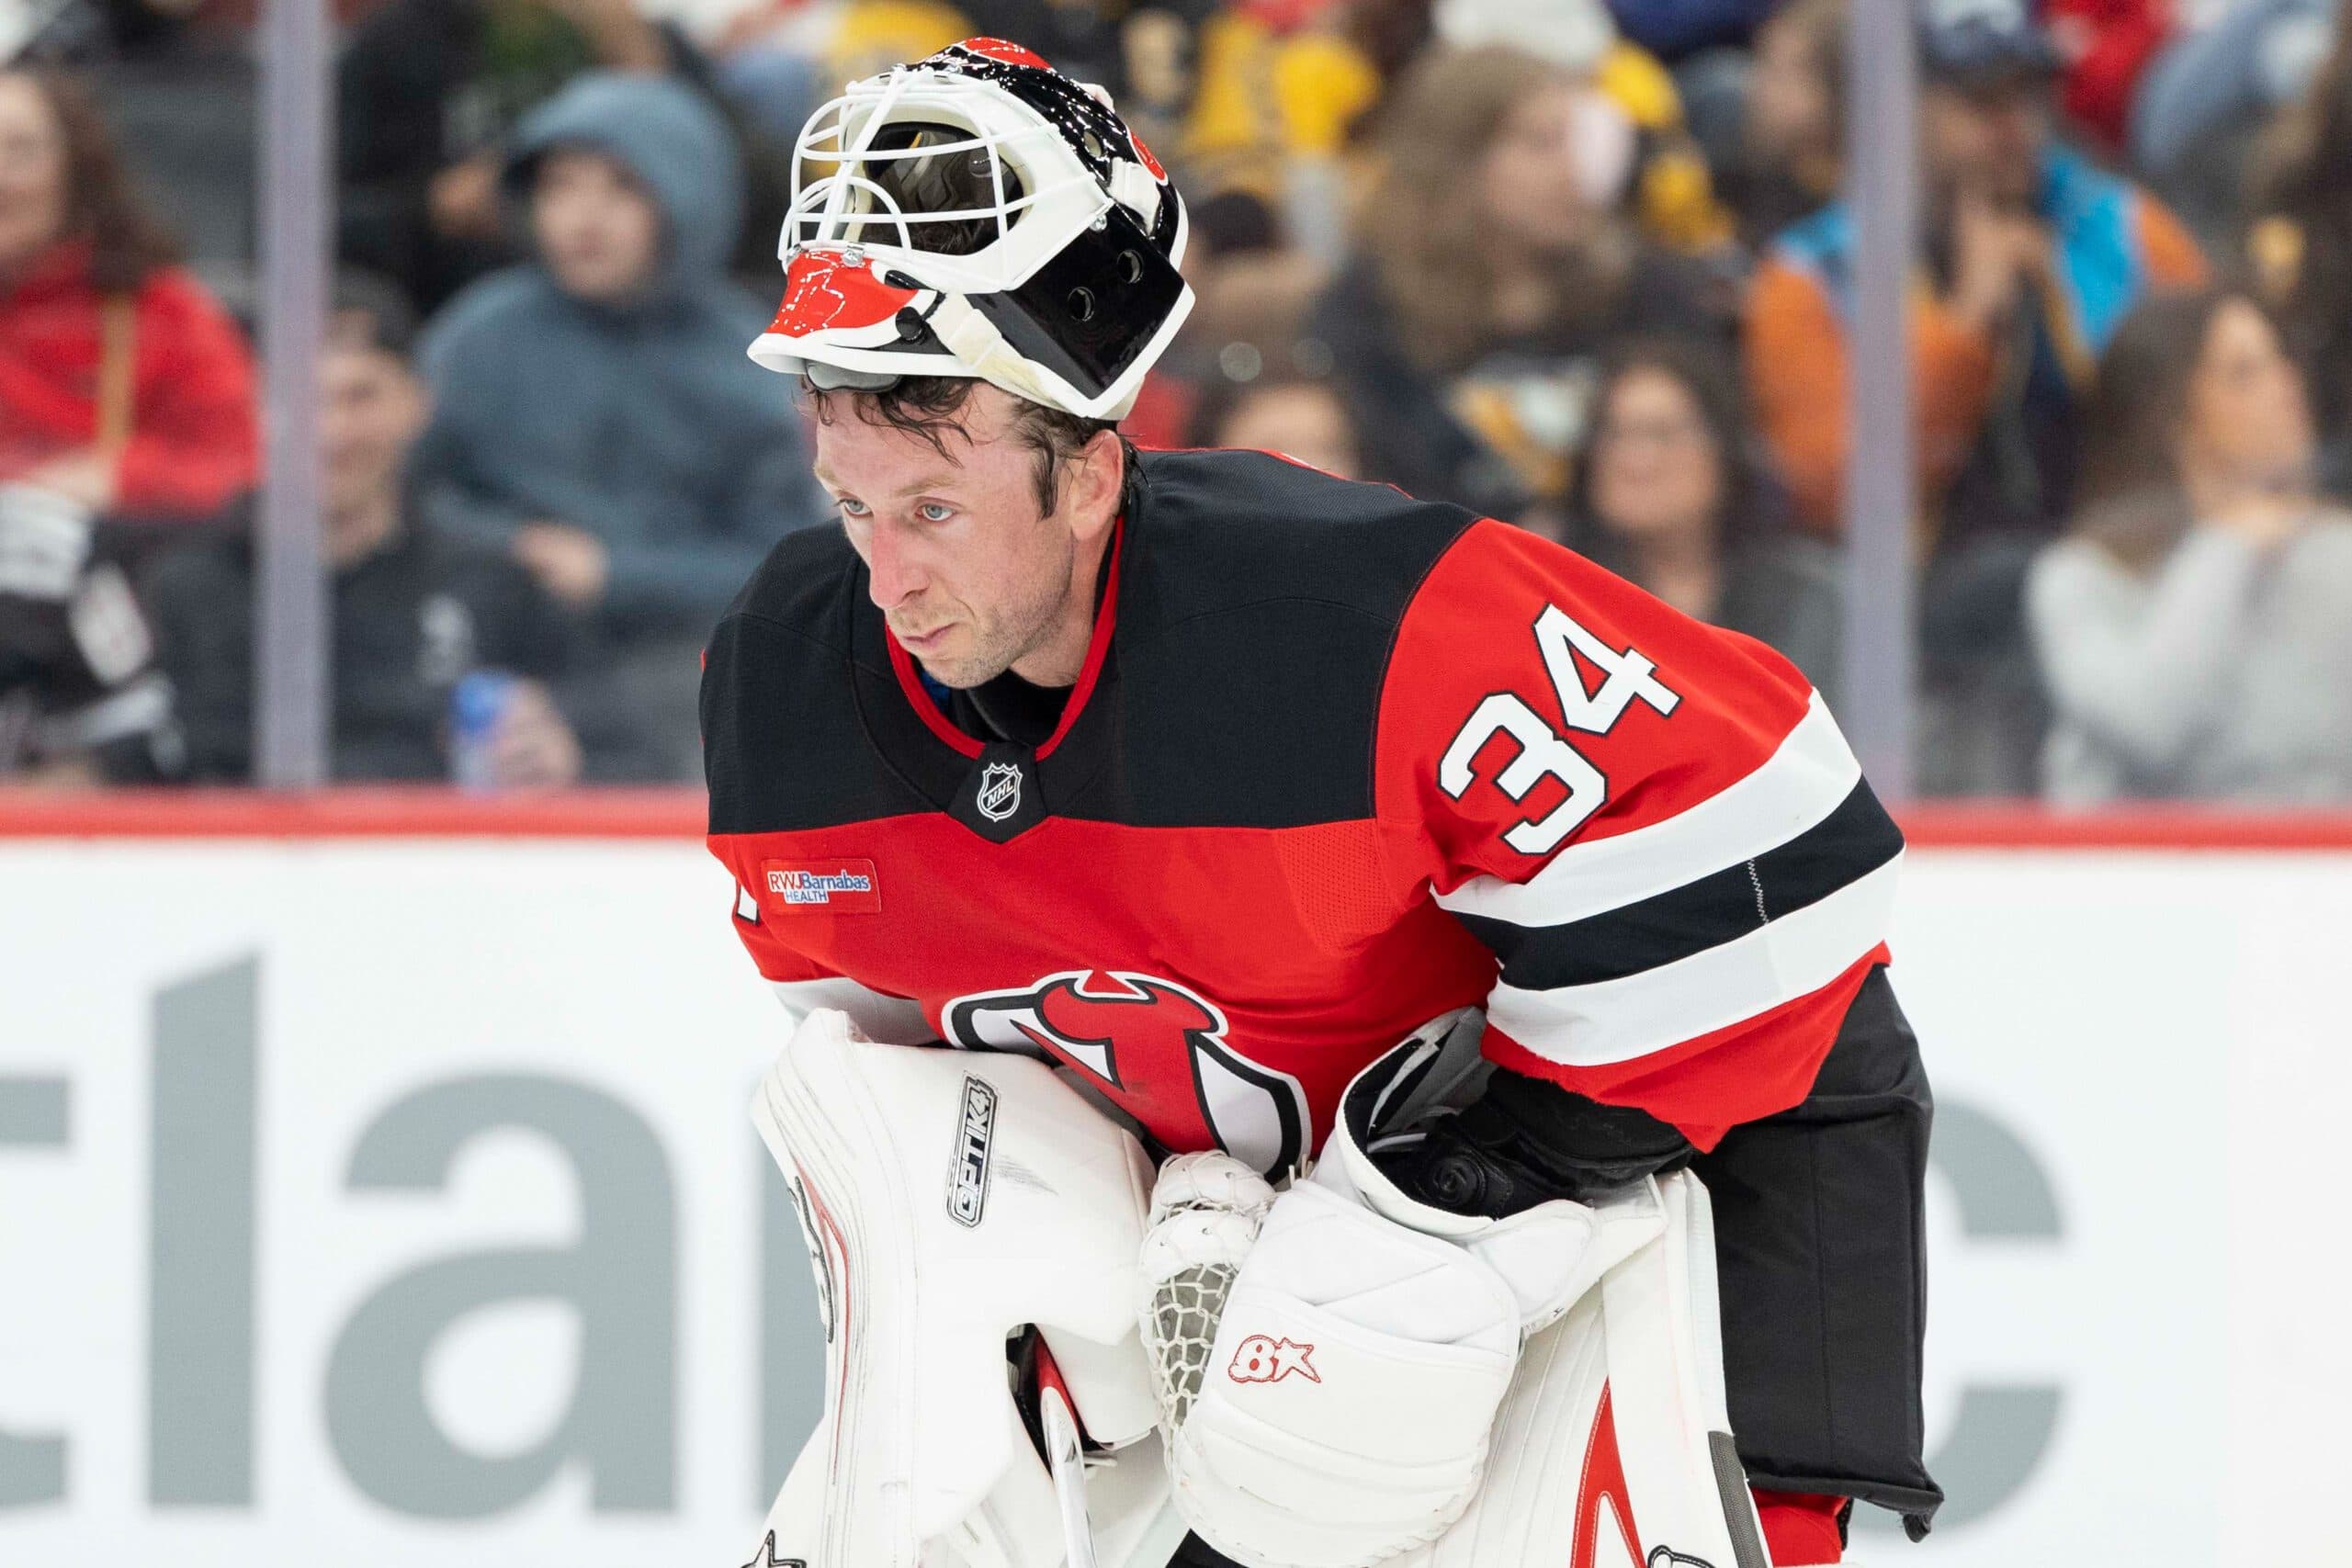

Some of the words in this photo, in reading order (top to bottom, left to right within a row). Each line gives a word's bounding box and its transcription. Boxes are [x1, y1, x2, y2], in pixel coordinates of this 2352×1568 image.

[1437, 603, 1684, 855] 34
[987, 780, 1014, 807] NHL
[769, 871, 869, 890] RWJBarnabas
[786, 890, 827, 902] HEALTH
